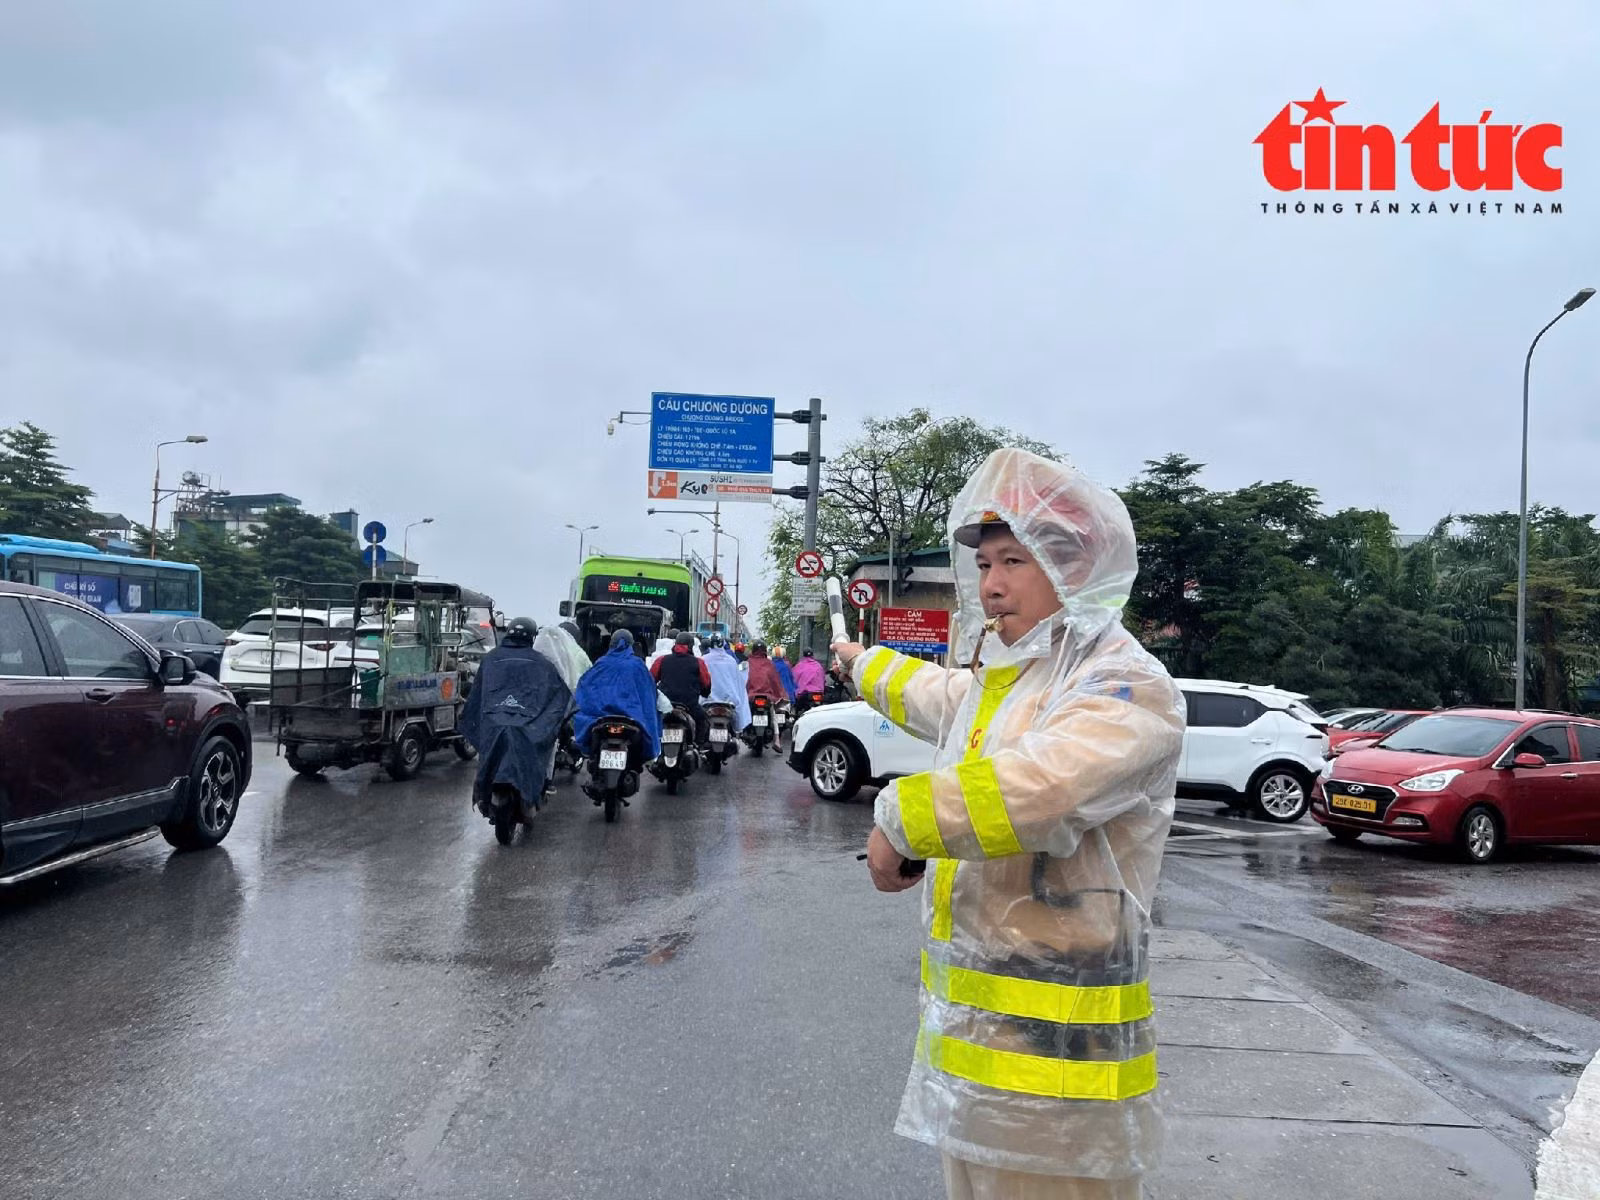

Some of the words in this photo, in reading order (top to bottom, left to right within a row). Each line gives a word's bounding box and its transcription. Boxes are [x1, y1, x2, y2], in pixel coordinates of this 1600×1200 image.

[682, 400, 728, 414] CHƯƠNG
[730, 402, 768, 415] DƯƠNG
[709, 474, 733, 484] SUSHI
[907, 608, 922, 618] CẤM
